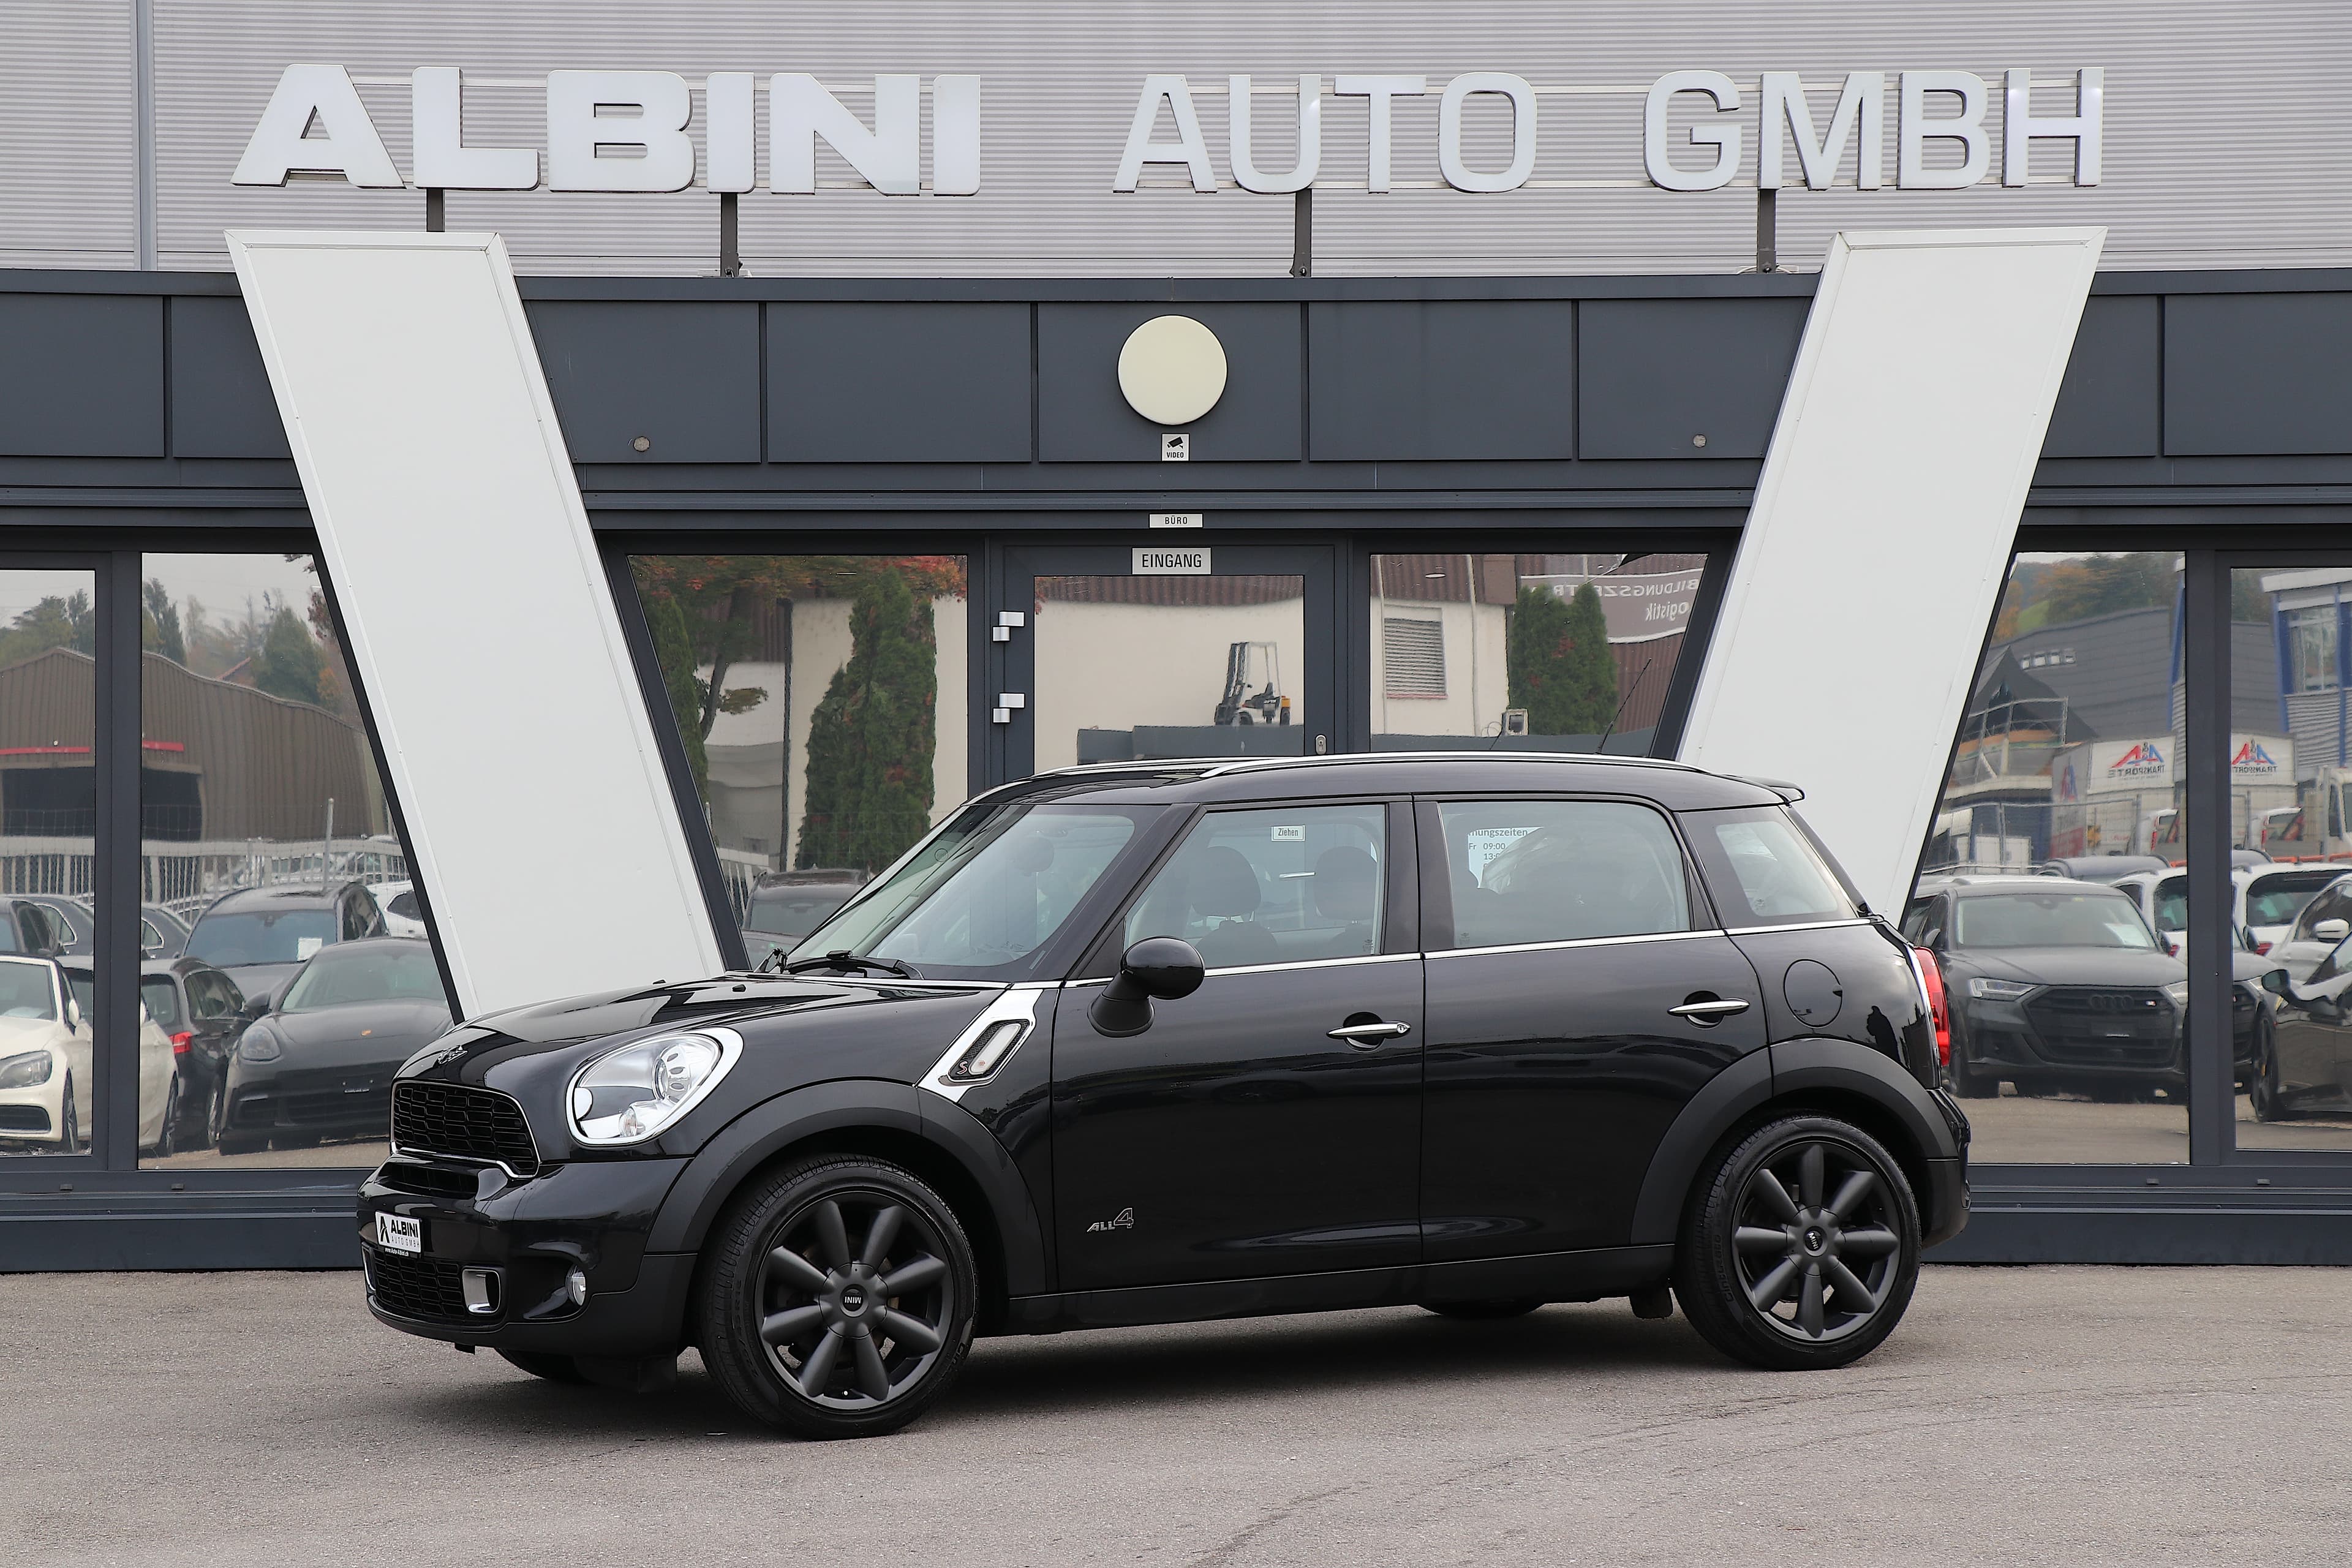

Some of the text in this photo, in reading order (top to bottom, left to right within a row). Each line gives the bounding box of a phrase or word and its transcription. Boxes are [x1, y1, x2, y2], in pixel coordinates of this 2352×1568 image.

[229, 62, 2105, 196] ALBINI AUTO GMBH
[1164, 515, 1188, 525] BÜRO
[1141, 553, 1202, 568] EINGANG
[1278, 827, 1299, 837] Ziehen
[957, 1061, 968, 1074] S
[391, 1219, 419, 1238] ALBINI
[391, 1235, 420, 1249] AUTO GMBH
[1808, 1232, 1819, 1250] MINI
